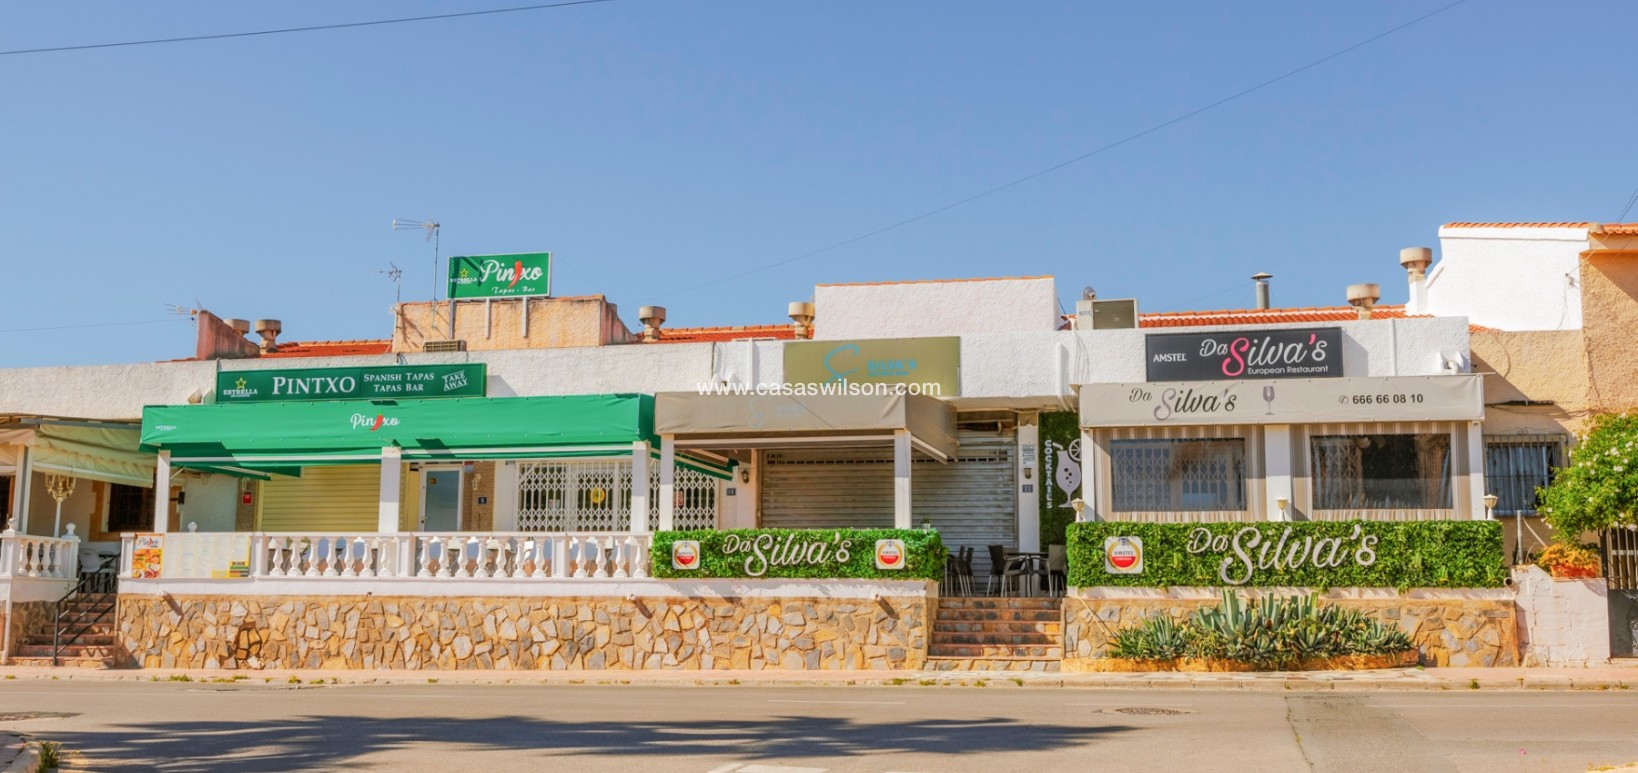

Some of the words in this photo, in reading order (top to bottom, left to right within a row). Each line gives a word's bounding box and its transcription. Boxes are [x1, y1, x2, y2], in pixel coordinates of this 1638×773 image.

[491, 286, 515, 295] Tapas
[522, 285, 536, 293] Bar
[1153, 353, 1187, 362] AMSTEL
[1200, 338, 1228, 357] Da
[1221, 333, 1328, 377] Silva's
[1247, 366, 1286, 375] European
[1286, 365, 1329, 374] Restaurant
[363, 373, 402, 382] SPANISH
[405, 372, 435, 381] TAPAS
[441, 371, 466, 385] TAKE
[272, 376, 356, 395] PINTXO
[373, 383, 402, 392] TAPAS
[405, 383, 424, 392] BAR
[443, 378, 468, 391] AWAY
[1129, 387, 1152, 402] Da
[1154, 387, 1237, 421] Silva's
[1352, 394, 1373, 405] 666
[1376, 394, 1390, 404] 66
[1393, 394, 1407, 404] 08
[1411, 393, 1424, 403] 10
[1044, 439, 1053, 509] COCKTAILS
[722, 534, 750, 554] Da
[744, 532, 852, 576] Silva's
[1186, 527, 1229, 553] Da
[1220, 524, 1378, 585] Silva's
